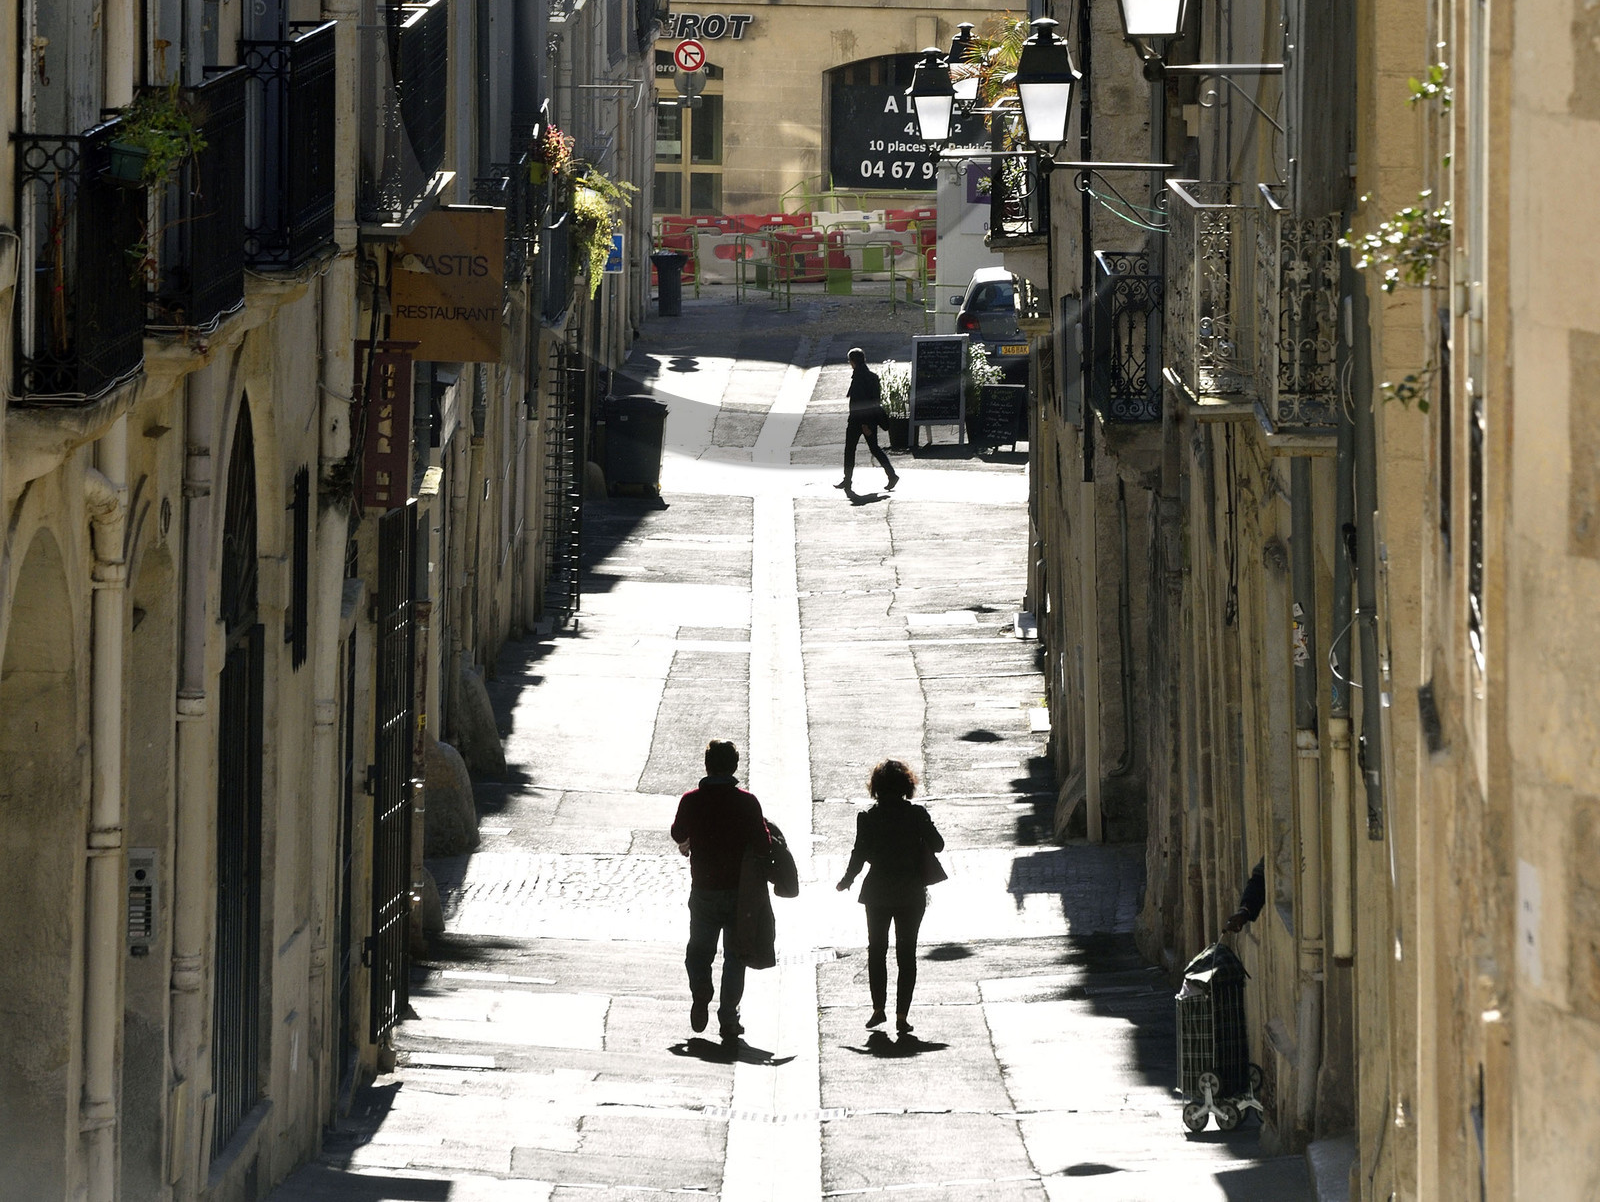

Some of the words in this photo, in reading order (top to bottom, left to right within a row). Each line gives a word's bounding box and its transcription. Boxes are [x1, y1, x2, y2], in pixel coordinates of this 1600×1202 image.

[869, 140, 884, 151] 10
[888, 141, 926, 153] places
[860, 160, 885, 178] 04
[891, 161, 915, 178] 67
[396, 304, 499, 321] RESTAURANT
